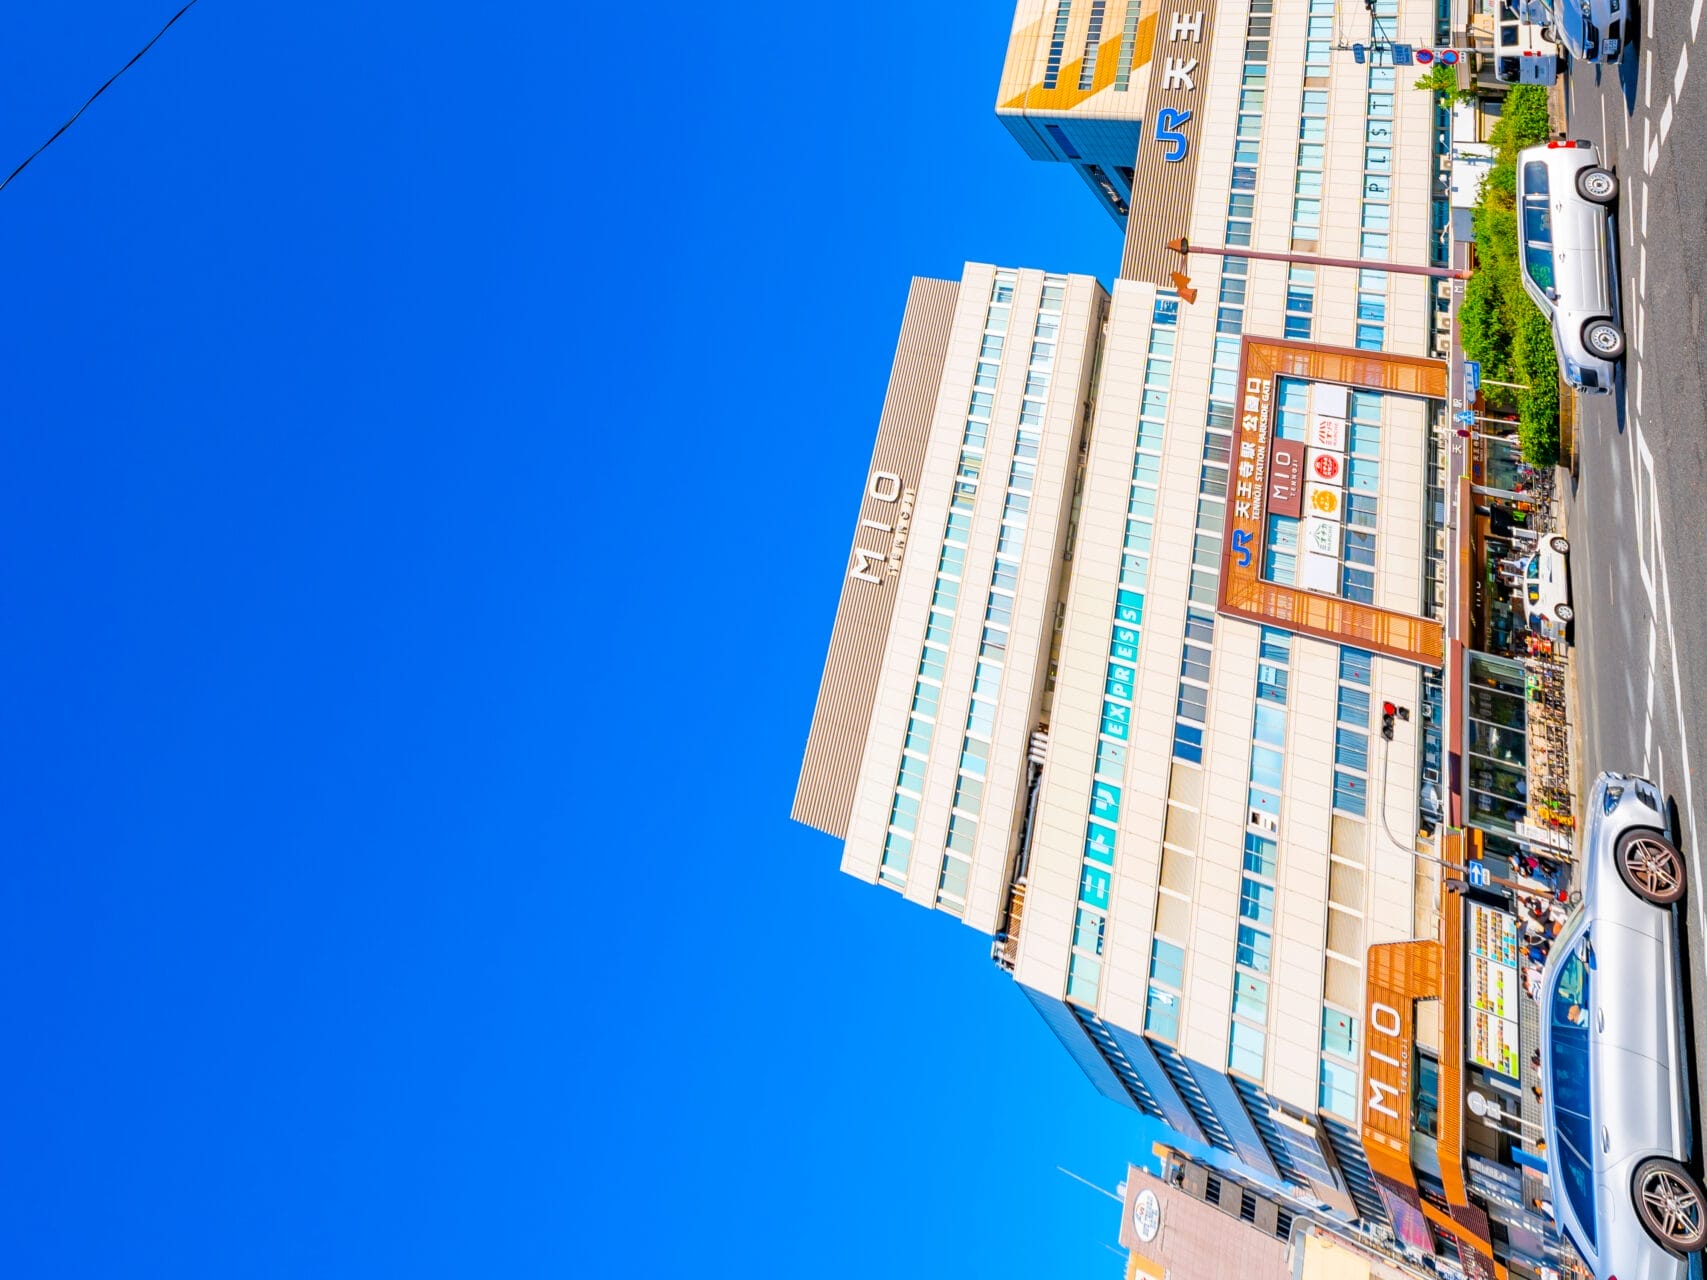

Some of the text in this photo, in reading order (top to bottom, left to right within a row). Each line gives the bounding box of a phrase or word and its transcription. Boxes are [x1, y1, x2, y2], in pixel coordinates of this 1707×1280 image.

[1153, 108, 1192, 162] JR
[1368, 101, 1389, 193] PLST
[1231, 377, 1261, 567] JR 天王寺駅 公園口
[1251, 379, 1271, 521] TENNOJI STATION PARKSIDE GATE
[1272, 451, 1292, 500] MIO
[1290, 459, 1299, 497] TENNOJI
[849, 471, 902, 585] MIO
[1085, 609, 1138, 899] ニトリ EXPRESS
[1368, 1002, 1400, 1119] MIO
